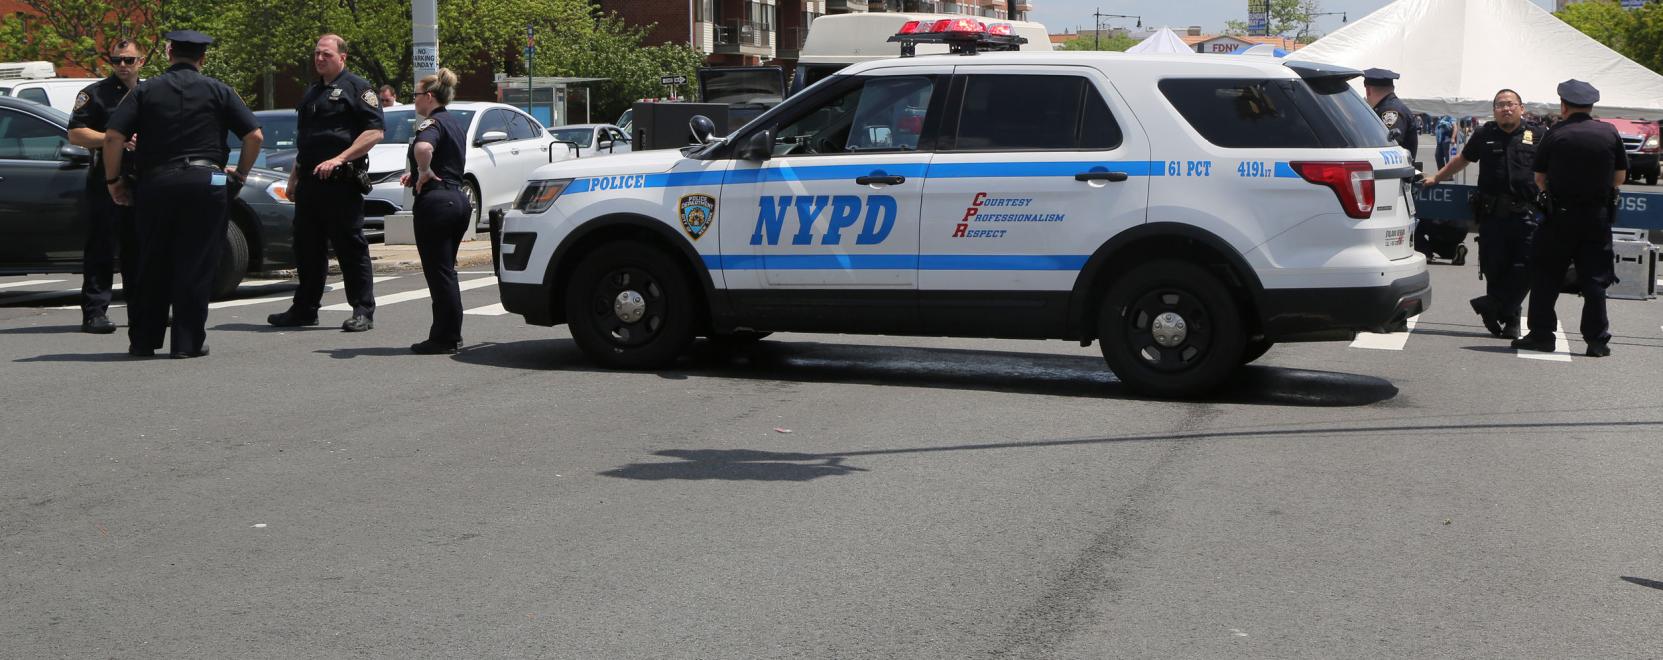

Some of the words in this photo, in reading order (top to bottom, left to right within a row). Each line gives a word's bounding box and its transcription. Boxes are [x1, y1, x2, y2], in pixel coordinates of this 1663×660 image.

[1213, 44, 1239, 52] FDNY
[1168, 160, 1181, 176] 61
[1187, 161, 1211, 176] PCT
[590, 175, 644, 191] POLICE
[1618, 196, 1648, 211] OSS
[750, 194, 898, 246] NYPD
